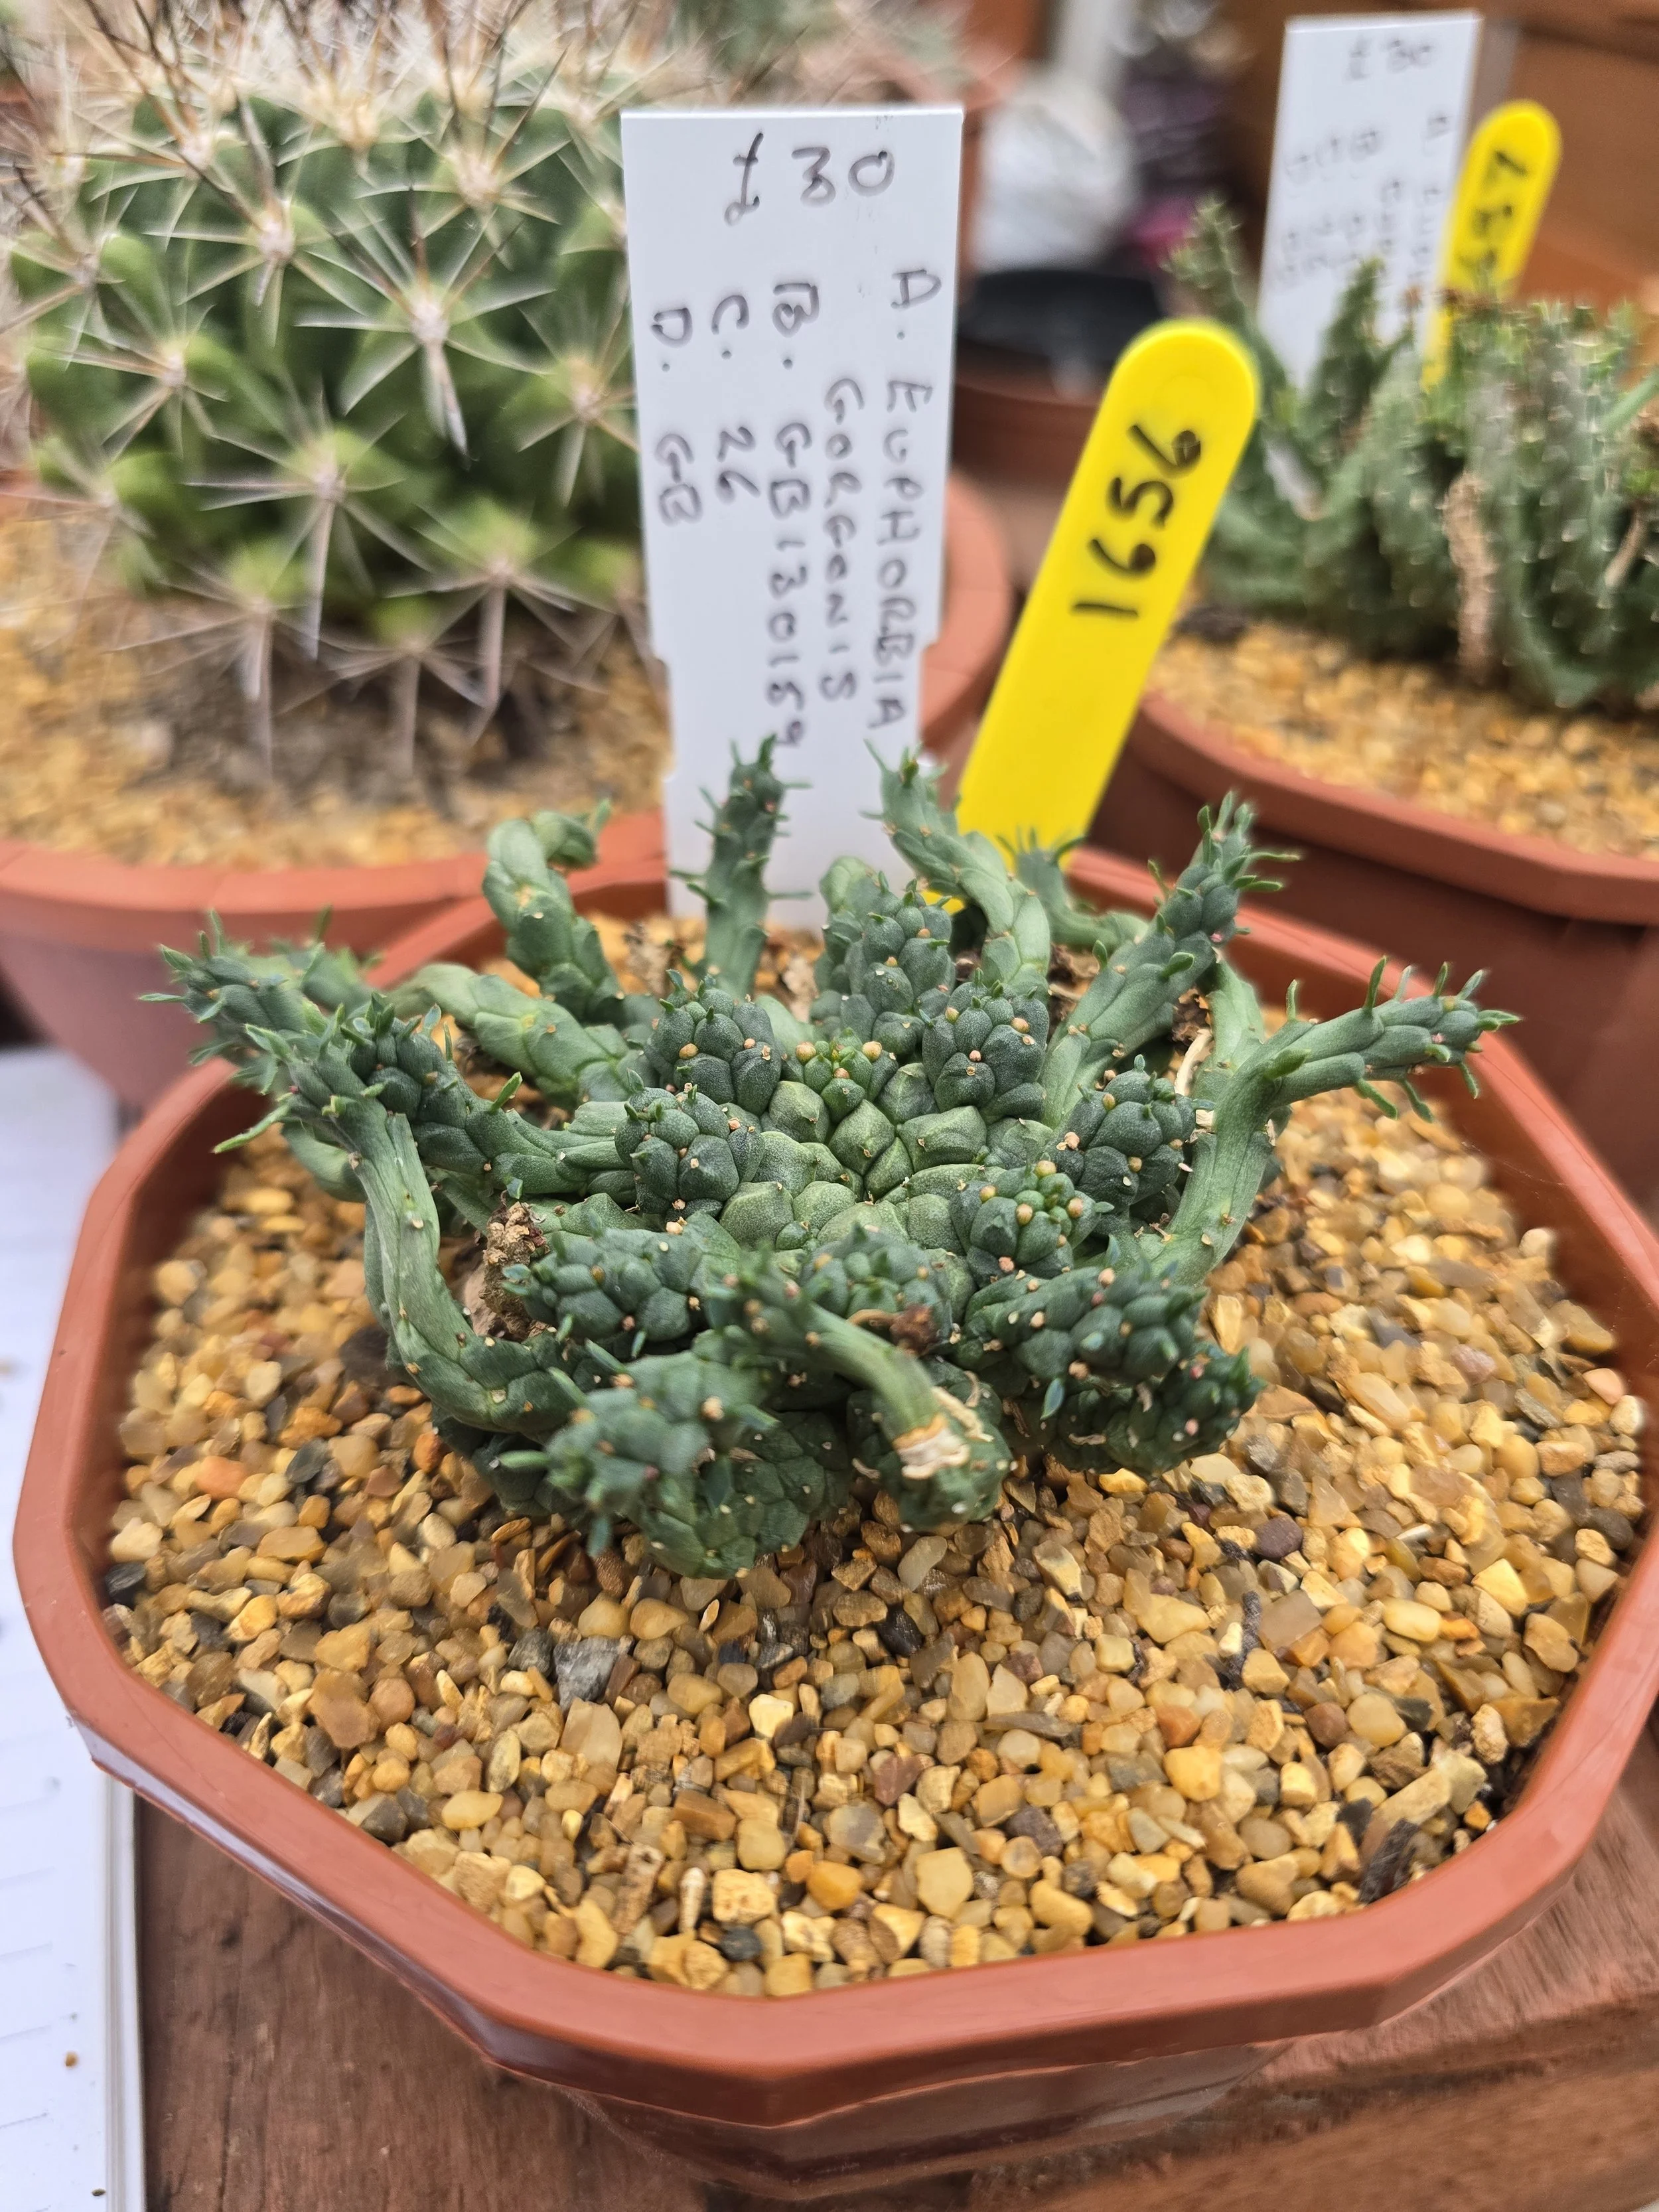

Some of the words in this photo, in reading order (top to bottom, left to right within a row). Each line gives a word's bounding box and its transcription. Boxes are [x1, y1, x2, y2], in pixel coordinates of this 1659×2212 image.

[723, 131, 895, 226] £30
[650, 307, 693, 372] D.
[711, 294, 750, 360] C.
[772, 282, 820, 369] B.
[890, 268, 942, 340] A.
[655, 433, 704, 526] GB
[717, 426, 761, 504] 26
[819, 378, 864, 701] GORGONIS
[867, 380, 933, 729] EUPHORBIA
[1070, 424, 1202, 621] 1656
